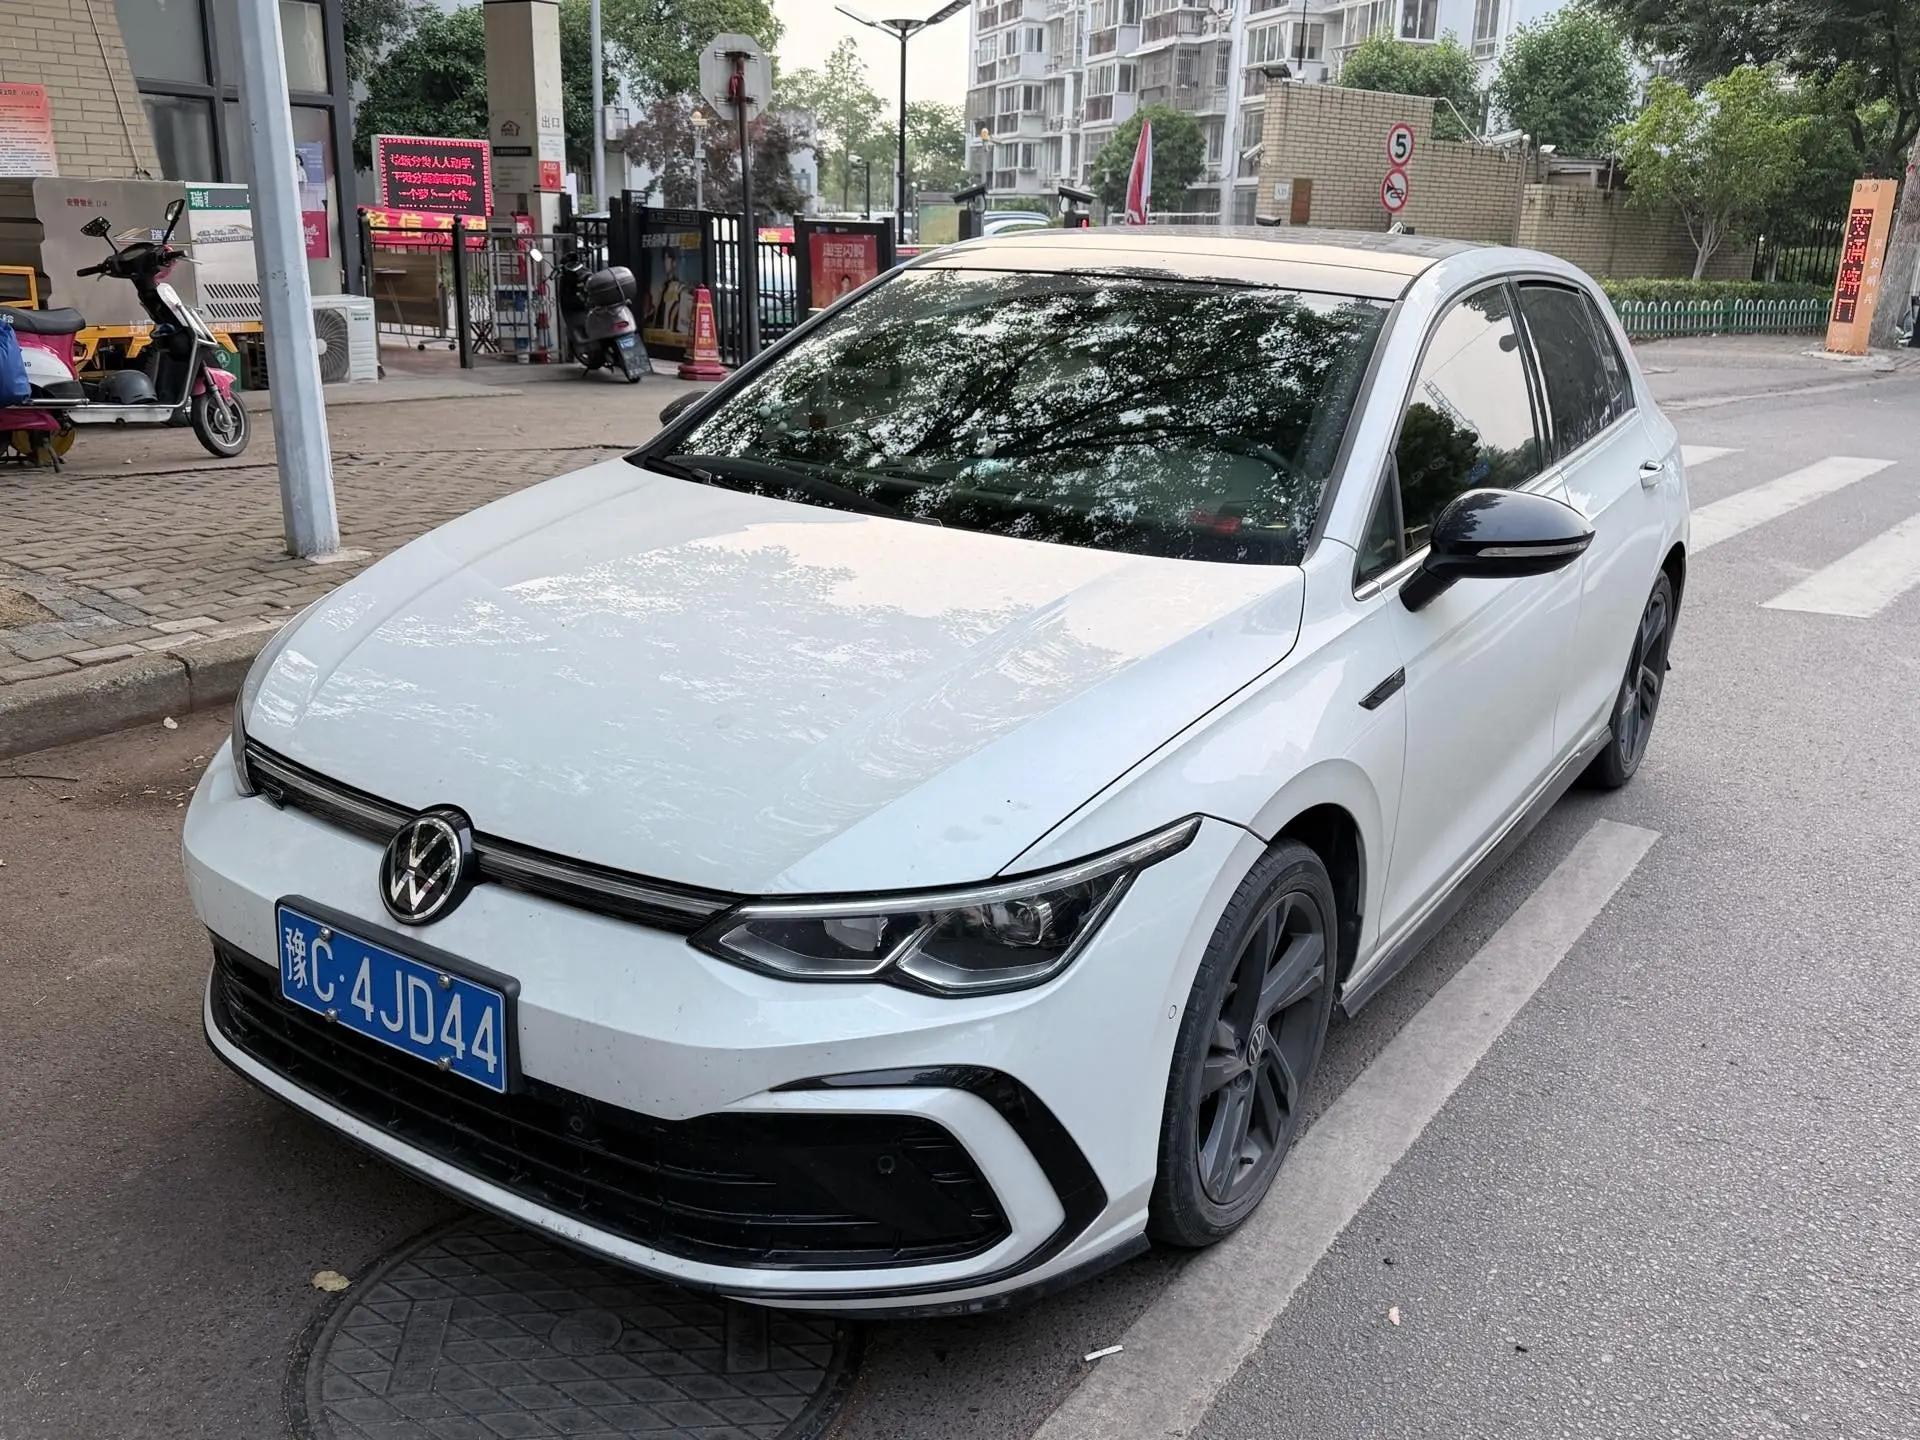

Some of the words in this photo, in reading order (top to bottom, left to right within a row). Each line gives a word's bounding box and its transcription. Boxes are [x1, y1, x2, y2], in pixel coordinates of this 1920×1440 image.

[541, 115, 560, 129] 出口
[1395, 134, 1406, 159] 5
[824, 243, 864, 257] 淘宝闪购
[284, 927, 498, 1074] 豫C·4JD44
